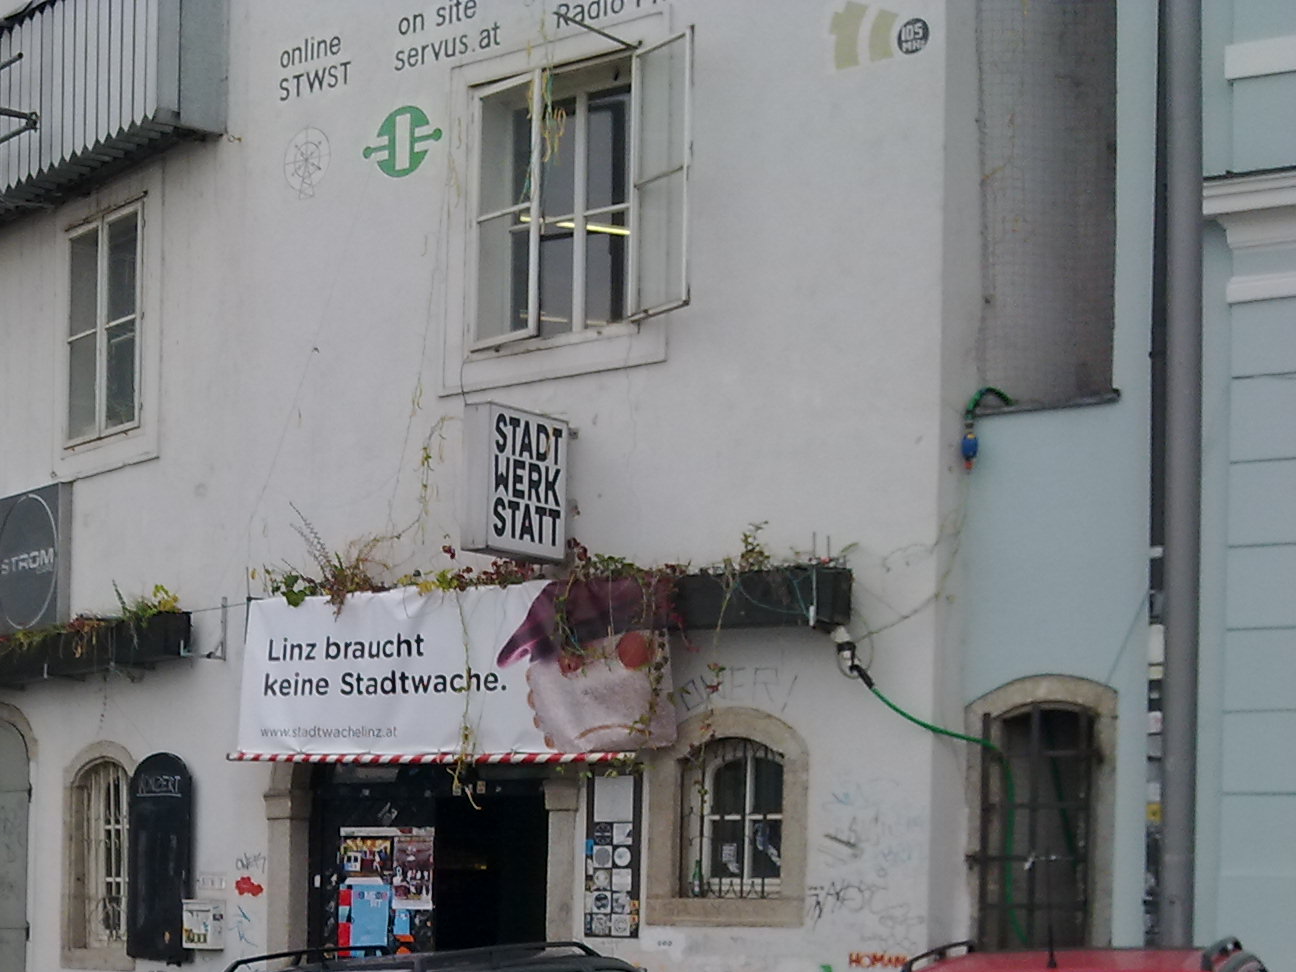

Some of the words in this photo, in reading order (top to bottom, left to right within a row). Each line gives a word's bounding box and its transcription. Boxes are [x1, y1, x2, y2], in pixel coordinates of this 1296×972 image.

[398, 13, 425, 35] on
[436, 0, 477, 27] site
[556, 0, 624, 29] Radio
[280, 35, 342, 68] online
[394, 22, 501, 71] servus.at
[279, 60, 352, 101] STWST
[495, 413, 563, 465] STADT
[494, 454, 561, 507] WERK
[493, 497, 561, 547] STATT
[0, 548, 54, 575] STROM
[267, 637, 317, 662] Linz
[325, 633, 425, 661] braucht
[263, 672, 330, 697] keine
[339, 670, 508, 697] Stadtwache.
